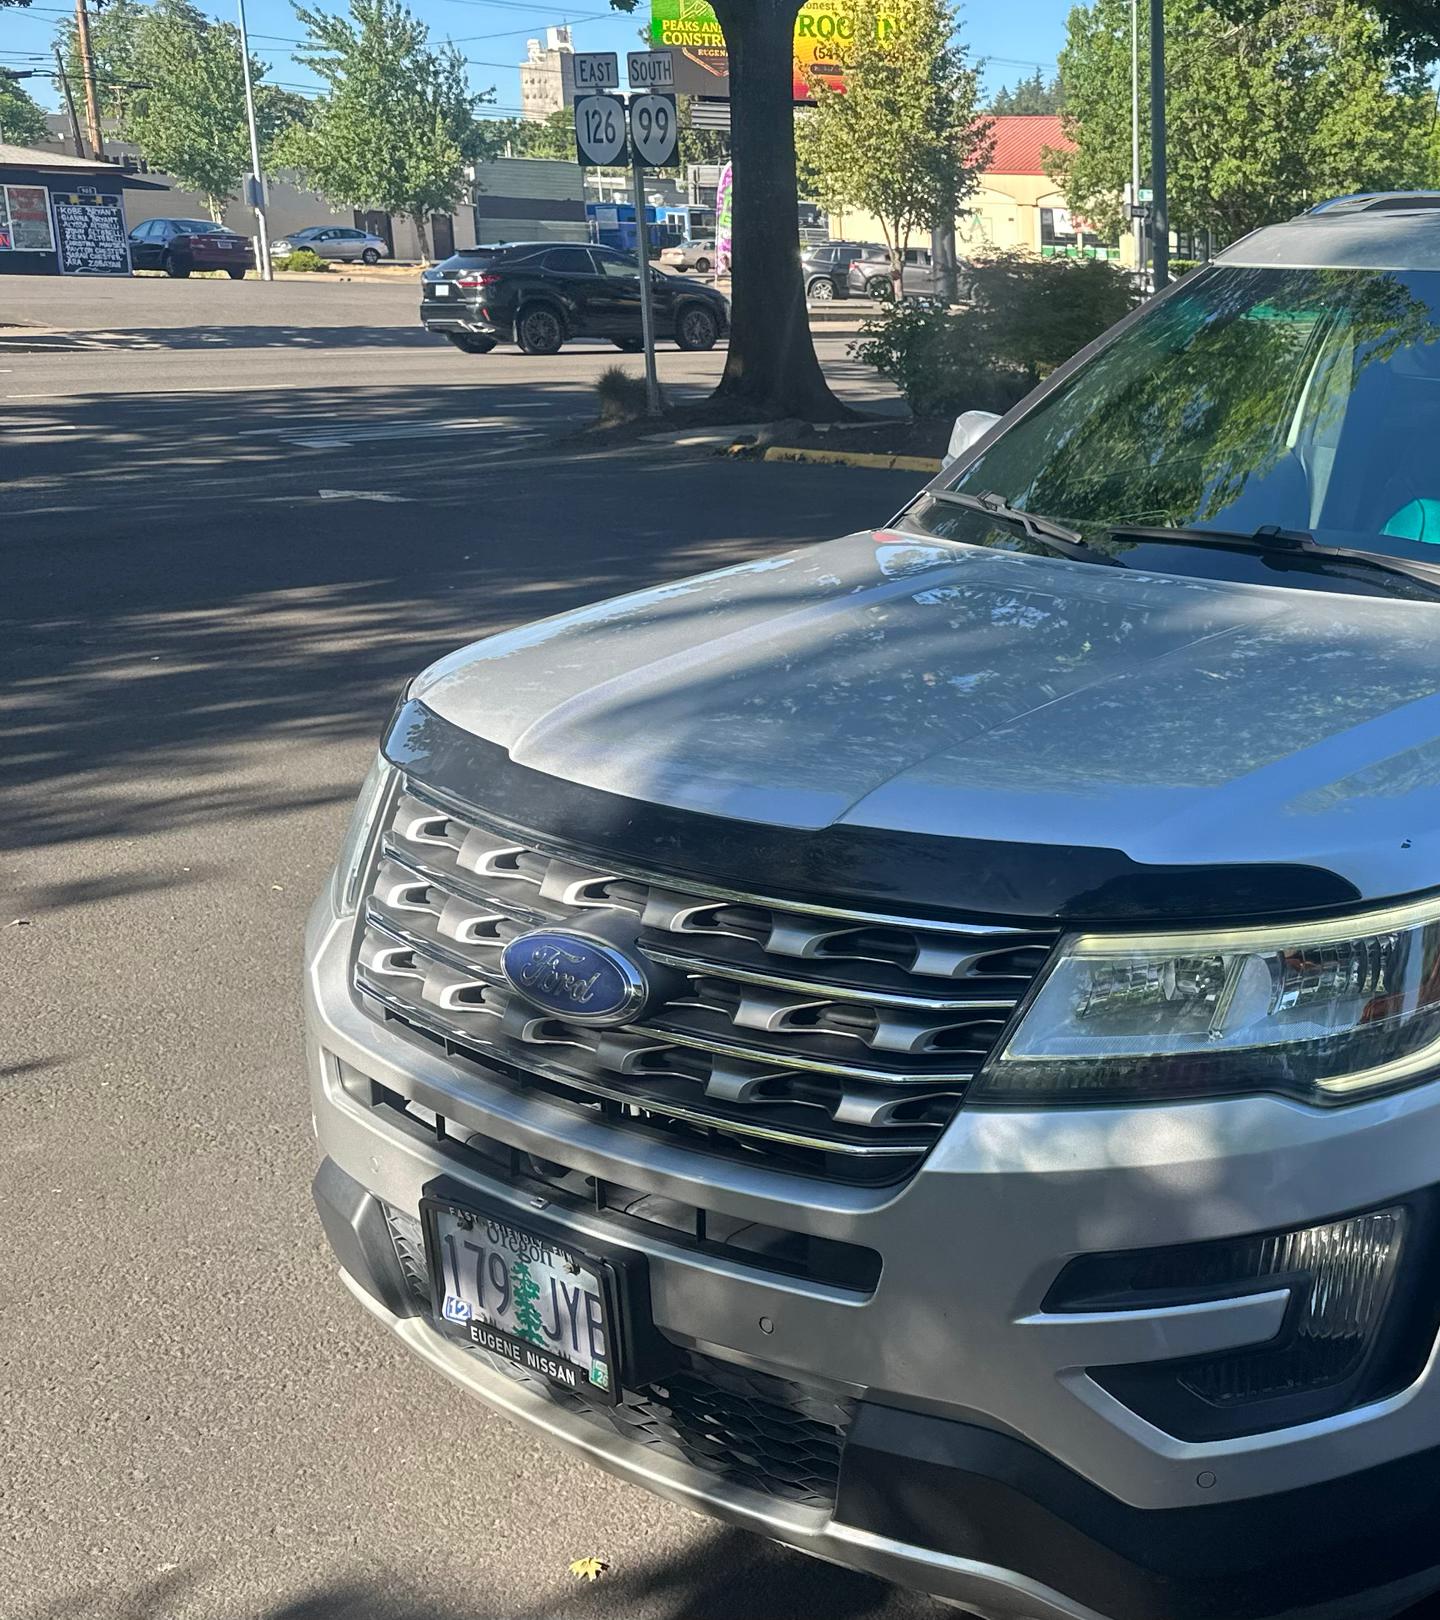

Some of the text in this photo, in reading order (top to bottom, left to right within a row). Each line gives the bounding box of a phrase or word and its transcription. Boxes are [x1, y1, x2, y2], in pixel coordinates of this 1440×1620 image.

[662, 20, 699, 32] PEAKS
[580, 60, 611, 82] EAST
[631, 59, 672, 81] SOUTH
[585, 109, 616, 144] 126
[639, 107, 669, 144] 99
[60, 207, 117, 216] KOBE BRYANT
[91, 215, 118, 223] BRYANT
[520, 944, 601, 1004] Ford
[487, 1227, 554, 1268] Oregon
[444, 1234, 509, 1316] 179
[450, 1301, 469, 1320] 12
[471, 1326, 576, 1386] EUGENE NISSAN
